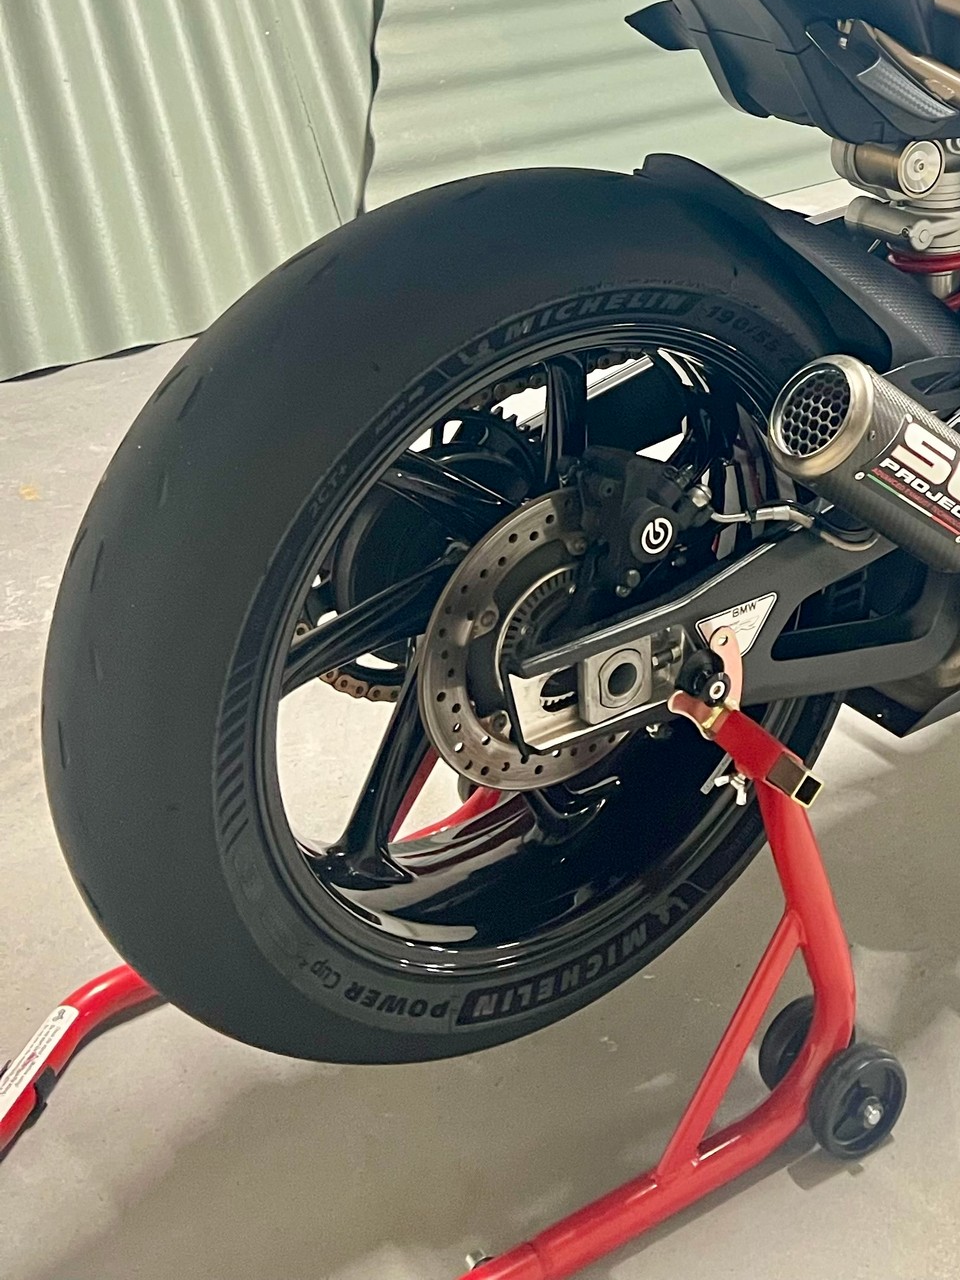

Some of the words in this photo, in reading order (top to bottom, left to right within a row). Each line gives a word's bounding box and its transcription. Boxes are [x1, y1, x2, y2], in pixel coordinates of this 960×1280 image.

[504, 292, 686, 342] MICHELIN
[732, 601, 758, 618] BMW
[472, 922, 650, 1018] MICHELIN
[343, 981, 450, 1019] POWER
